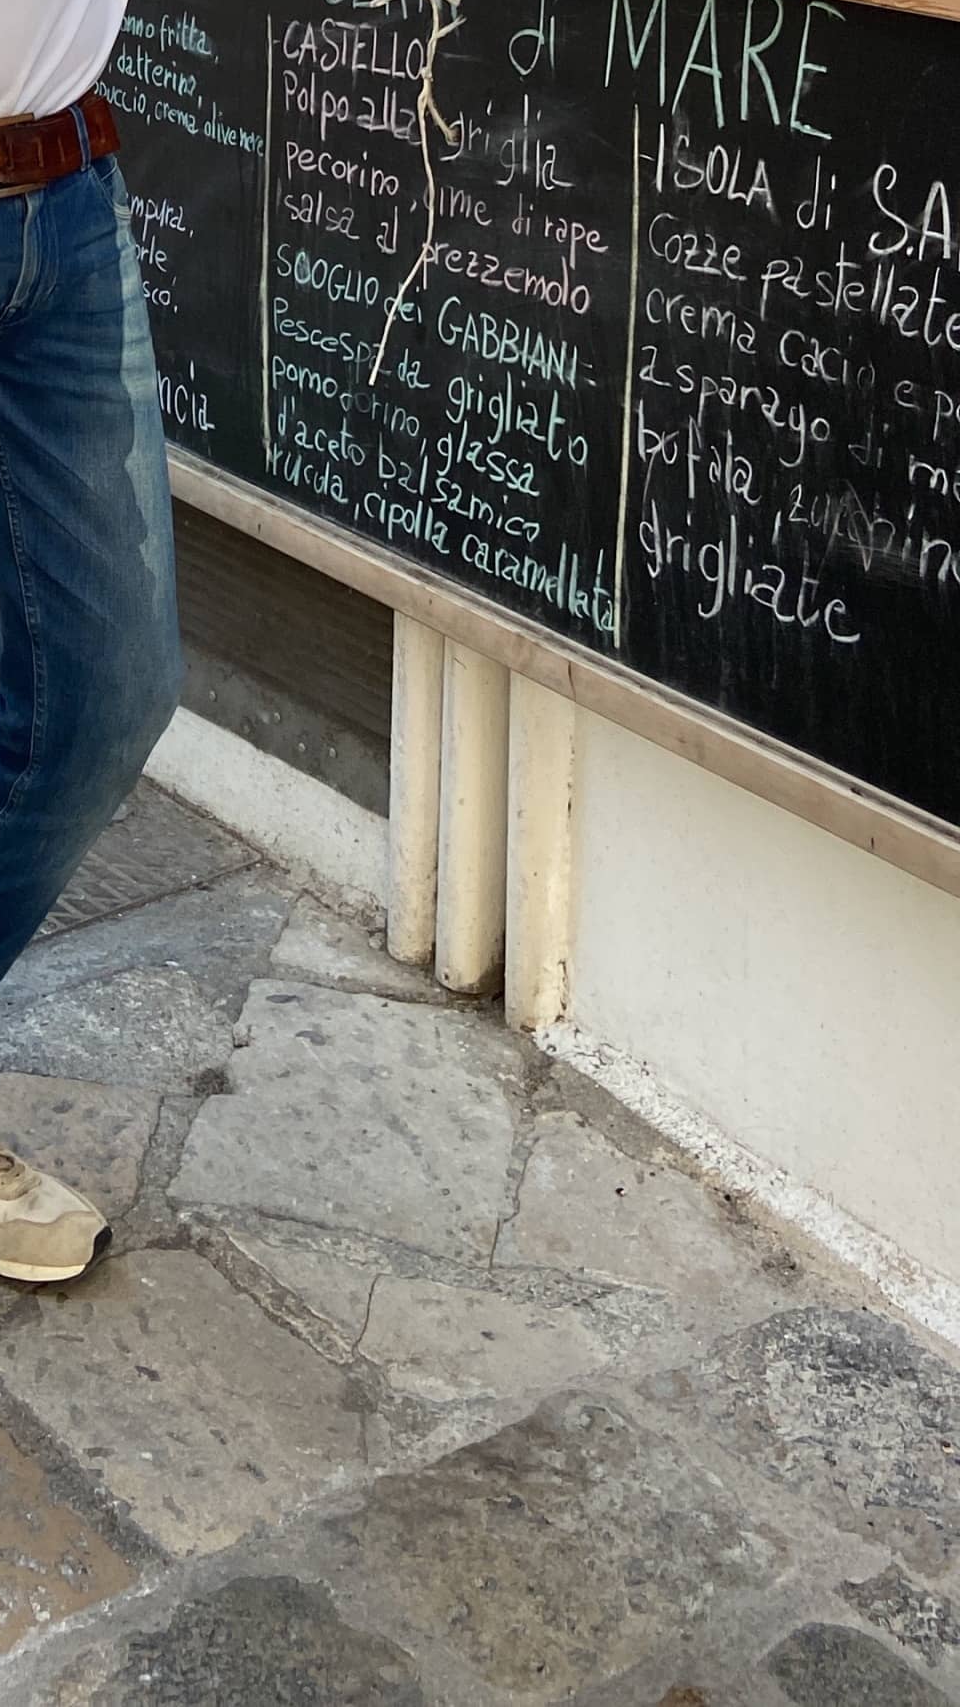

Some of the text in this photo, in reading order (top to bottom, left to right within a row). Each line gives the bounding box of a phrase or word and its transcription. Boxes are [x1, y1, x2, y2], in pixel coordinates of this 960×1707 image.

[154, 99, 199, 135] crema
[511, 194, 534, 237] di
[543, 212, 609, 270] rape
[797, 155, 837, 231] di
[868, 163, 960, 260] S.A
[284, 191, 360, 240] salsa
[422, 243, 590, 314] prezzemolo
[645, 288, 757, 354] crema
[437, 419, 539, 496] glassa
[364, 482, 450, 554] cipolla
